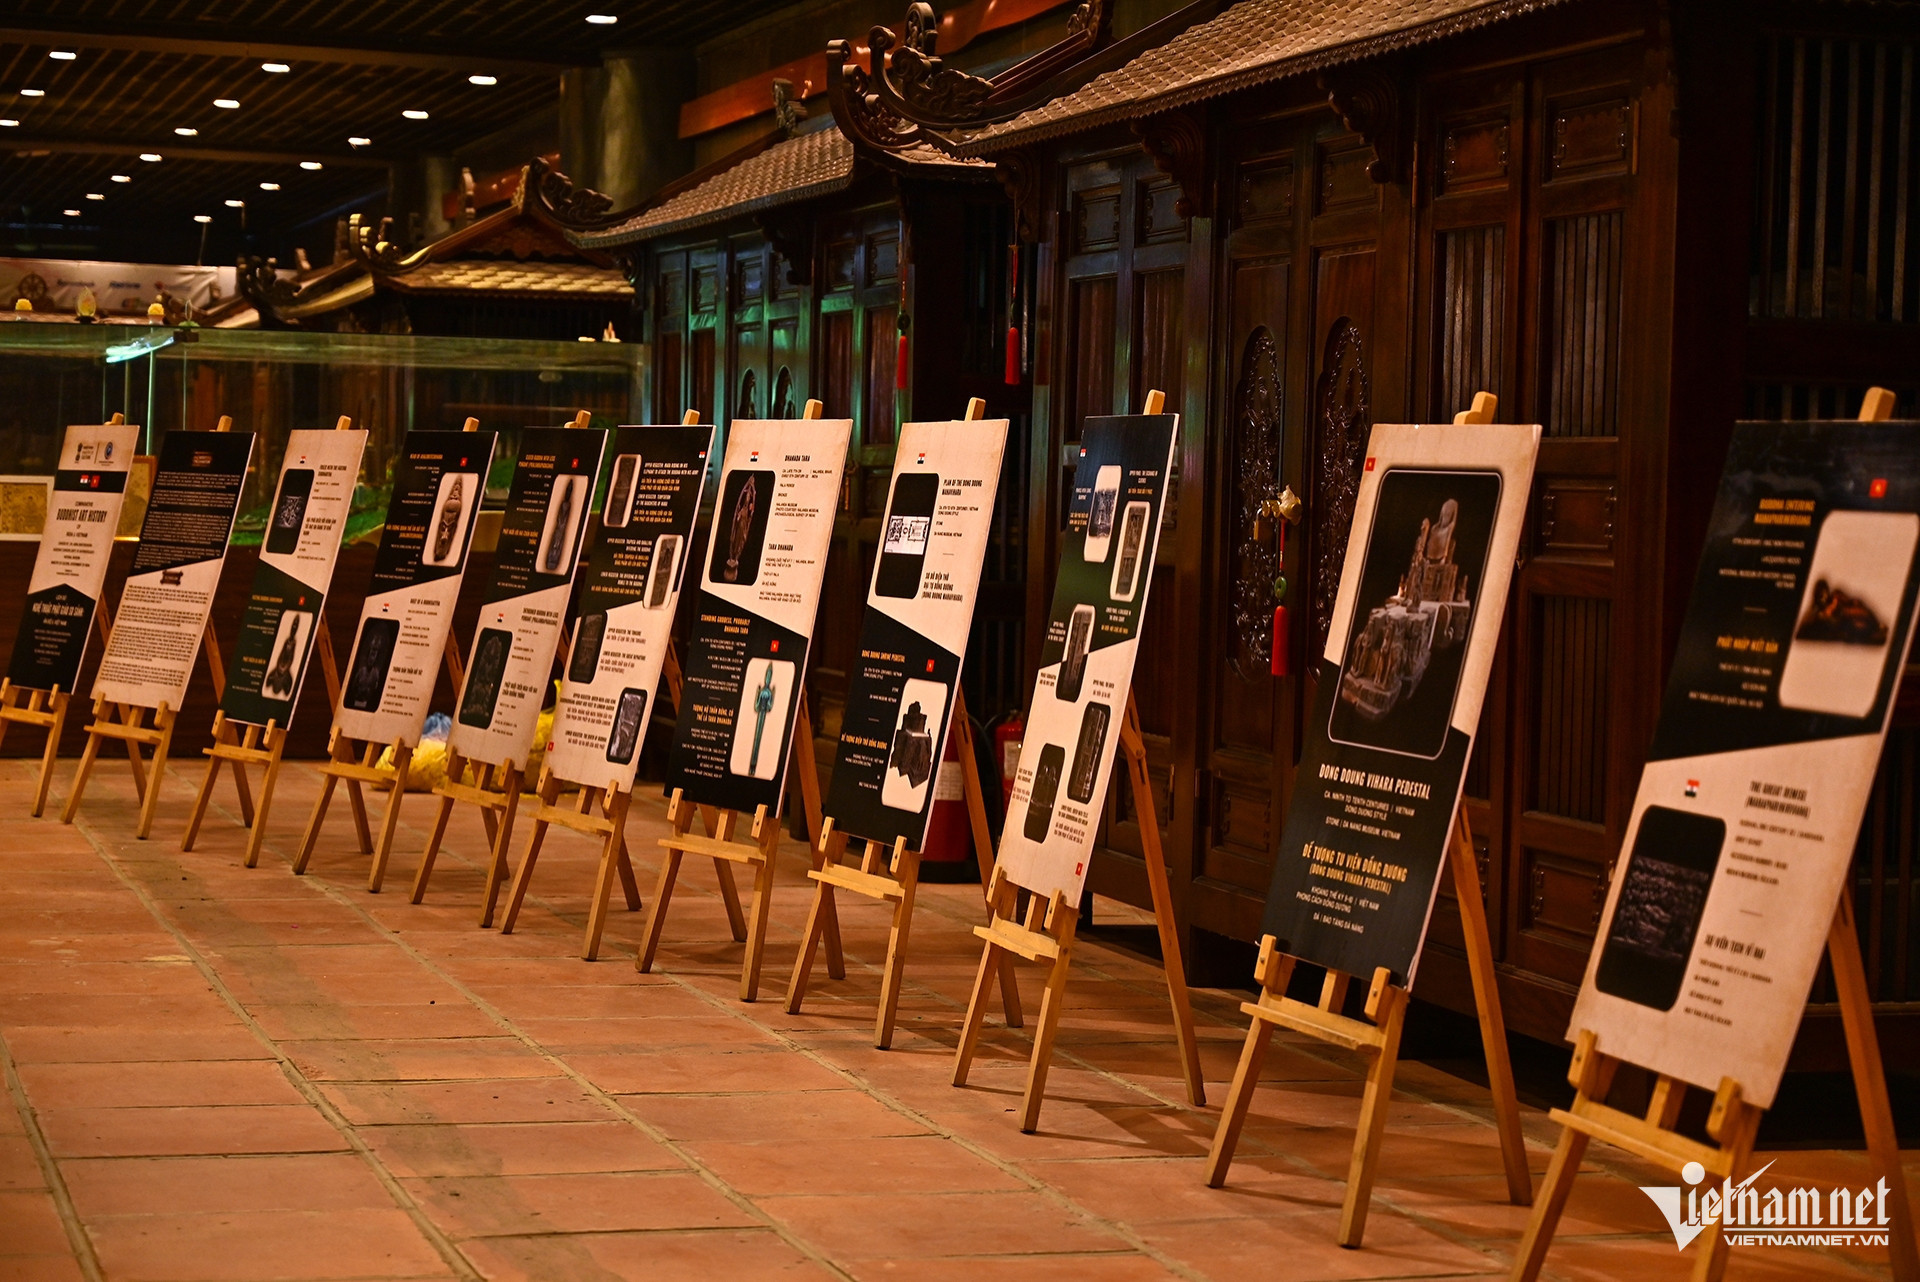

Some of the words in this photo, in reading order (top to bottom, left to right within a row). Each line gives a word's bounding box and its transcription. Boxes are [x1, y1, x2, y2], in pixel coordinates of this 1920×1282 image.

[783, 454, 802, 463] DHANADA
[800, 454, 811, 462] TARA
[55, 507, 80, 522] BUDDHIST
[77, 508, 89, 522] ART
[86, 509, 108, 523] HISTORY
[767, 543, 778, 551] TARA
[776, 543, 795, 552] DHANADA
[1318, 762, 1341, 782] DONG
[1339, 766, 1367, 787] DOUNG
[1365, 772, 1395, 793] VIHARA
[1393, 777, 1432, 801] PEDESTAL
[1343, 803, 1359, 815] DONG
[1356, 806, 1374, 819] DUONG
[1372, 809, 1388, 822] STYLE
[1324, 815, 1341, 827] STONE
[1341, 819, 1350, 830] DA
[1348, 821, 1363, 832] NANG
[1380, 828, 1402, 841] VIETNAM
[1301, 838, 1317, 859] ĐẾ
[1308, 862, 1327, 878] (DONG
[1325, 866, 1345, 882] DOUNG
[1343, 871, 1365, 887] VIHARA
[1362, 876, 1393, 895] PEDESTAL)
[1295, 890, 1312, 903] PHONG
[1367, 900, 1381, 912] NAM
